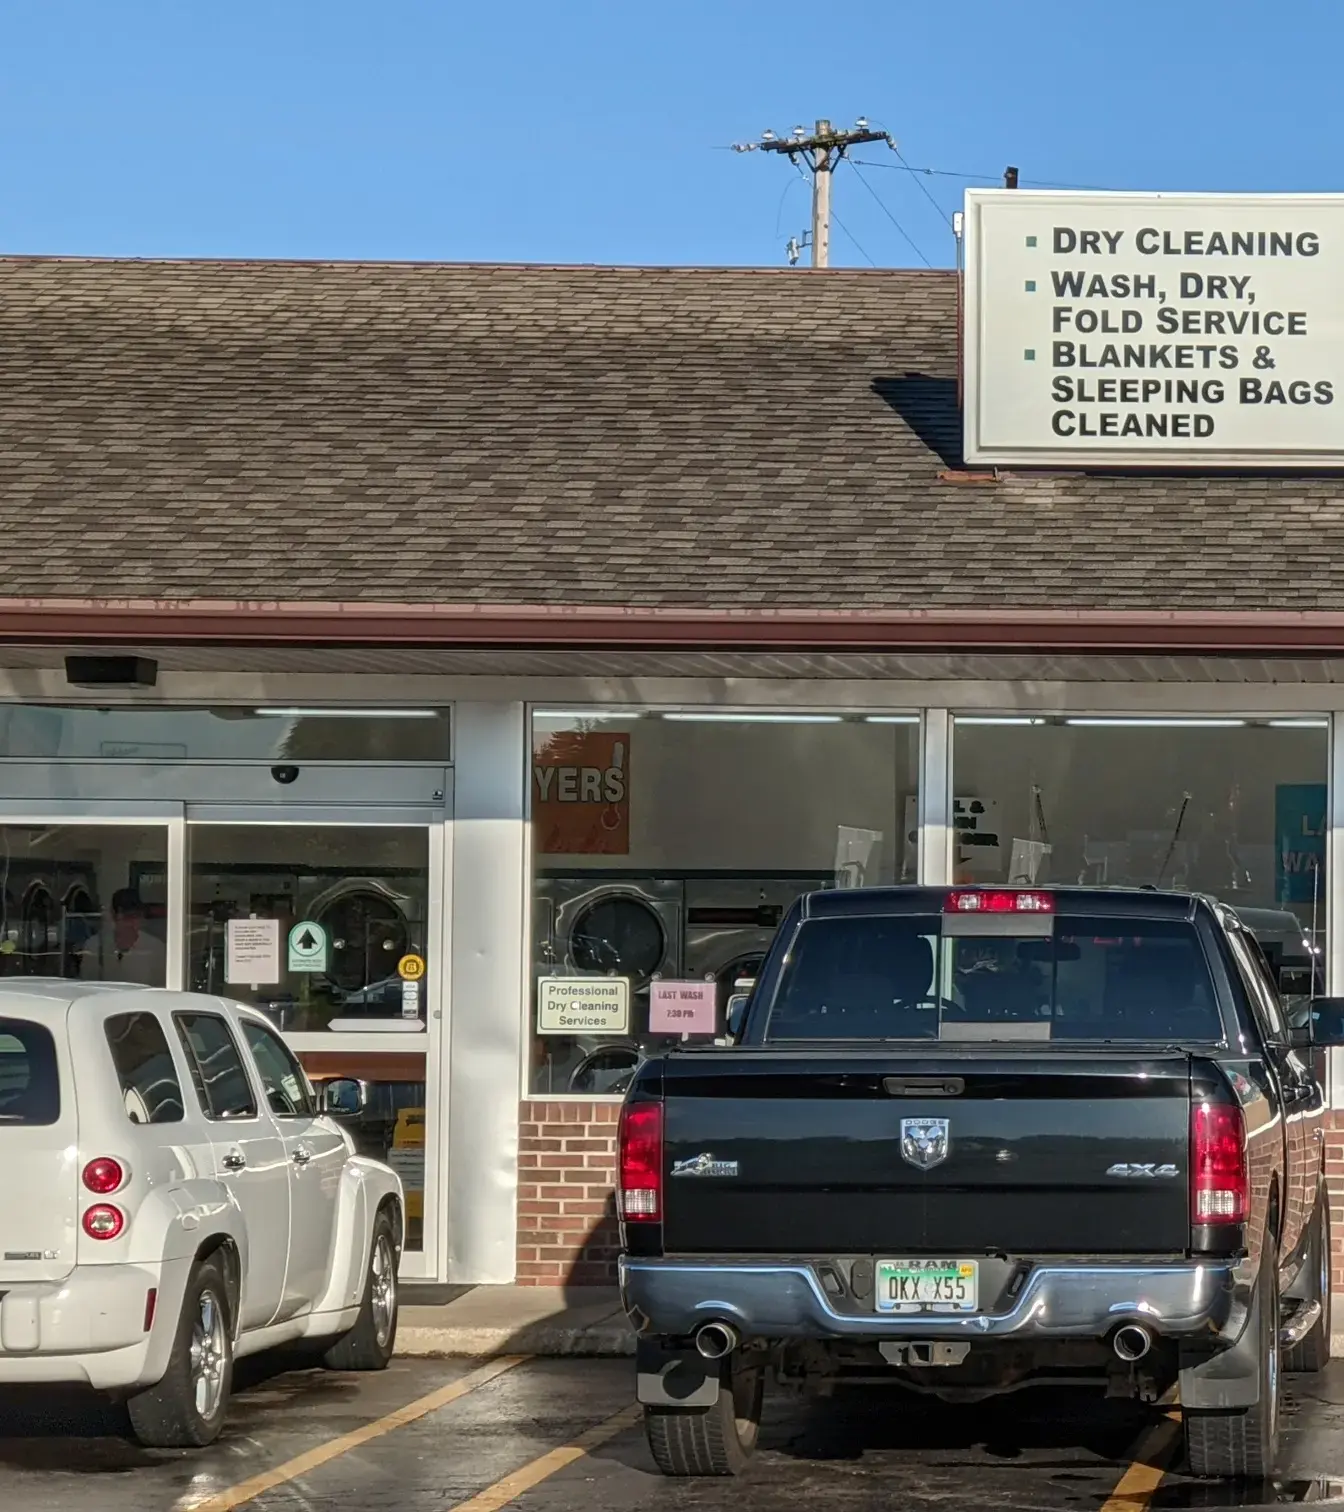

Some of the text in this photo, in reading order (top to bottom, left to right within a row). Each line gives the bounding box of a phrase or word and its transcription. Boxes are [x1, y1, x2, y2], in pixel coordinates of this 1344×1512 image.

[1052, 226, 1320, 257] DRY CLEANING
[1051, 270, 1256, 305] WASH, DRY,
[1052, 306, 1308, 336] FOLD SERVICE
[1052, 340, 1276, 370] BLANKETS &
[1051, 375, 1334, 405] SLEEPING BAGS
[1051, 409, 1215, 438] CLEANED
[549, 986, 618, 996] Professional
[658, 990, 704, 1000] LAST WASH
[547, 1001, 619, 1013] Dry Cleaning
[559, 1016, 607, 1026] Services
[908, 1260, 957, 1269] RAM
[933, 1276, 966, 1300] X55
